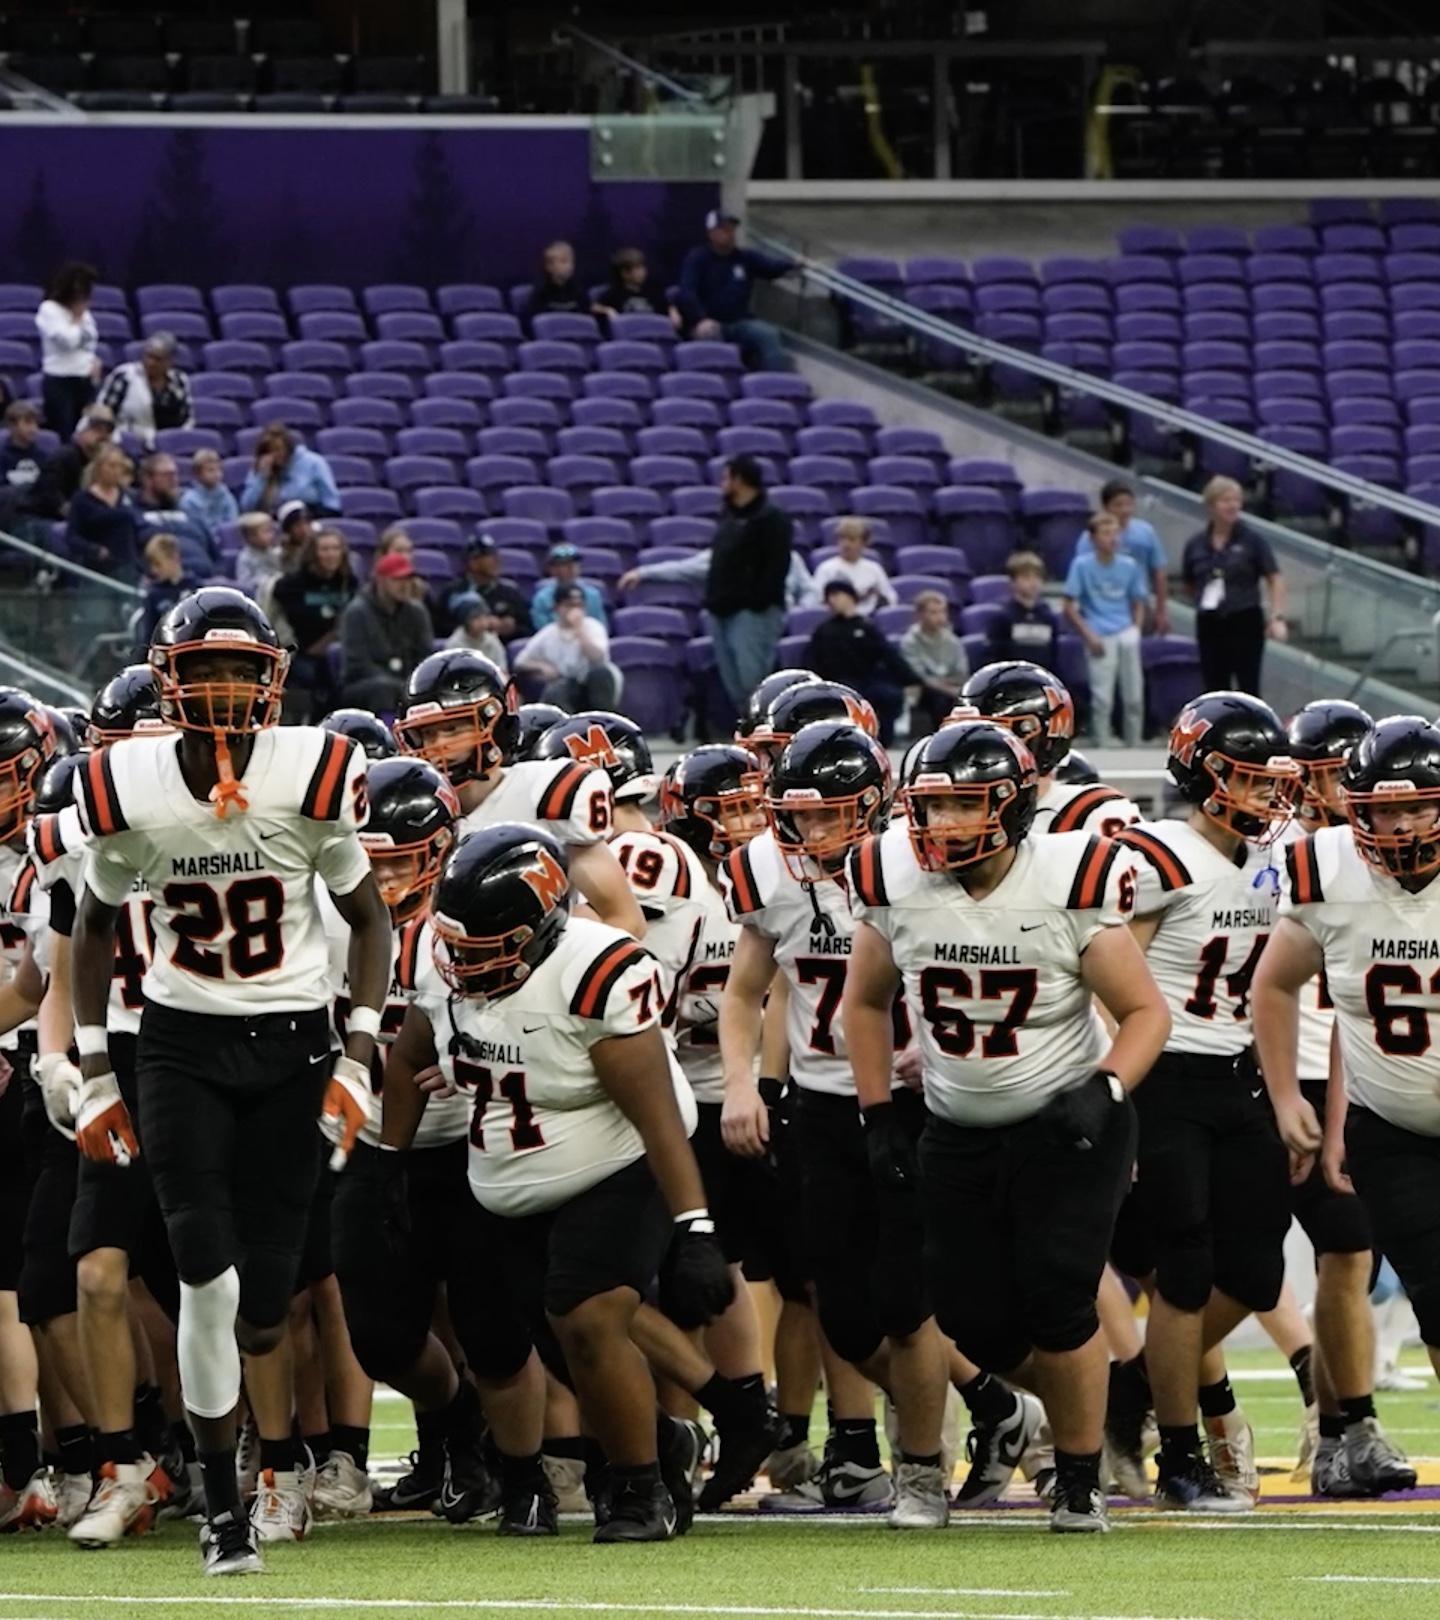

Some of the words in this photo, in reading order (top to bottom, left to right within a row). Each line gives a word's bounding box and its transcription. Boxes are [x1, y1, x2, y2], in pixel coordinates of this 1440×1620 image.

[563, 723, 621, 768] M
[1168, 708, 1213, 770] M
[588, 787, 613, 834] 6
[172, 852, 265, 877] MARSHALL
[521, 847, 569, 917] M
[618, 843, 664, 890] 19
[1117, 865, 1138, 914] 6
[162, 875, 285, 980] 28
[1211, 908, 1271, 929] MARSHALL
[934, 943, 1021, 965] MARSHALL
[1371, 938, 1440, 960] MARSHA
[1184, 933, 1271, 1022] 14
[920, 966, 1038, 1059] 67
[1365, 963, 1440, 1057] 6
[480, 1041, 524, 1064] SHALL
[453, 1055, 546, 1153] 71
